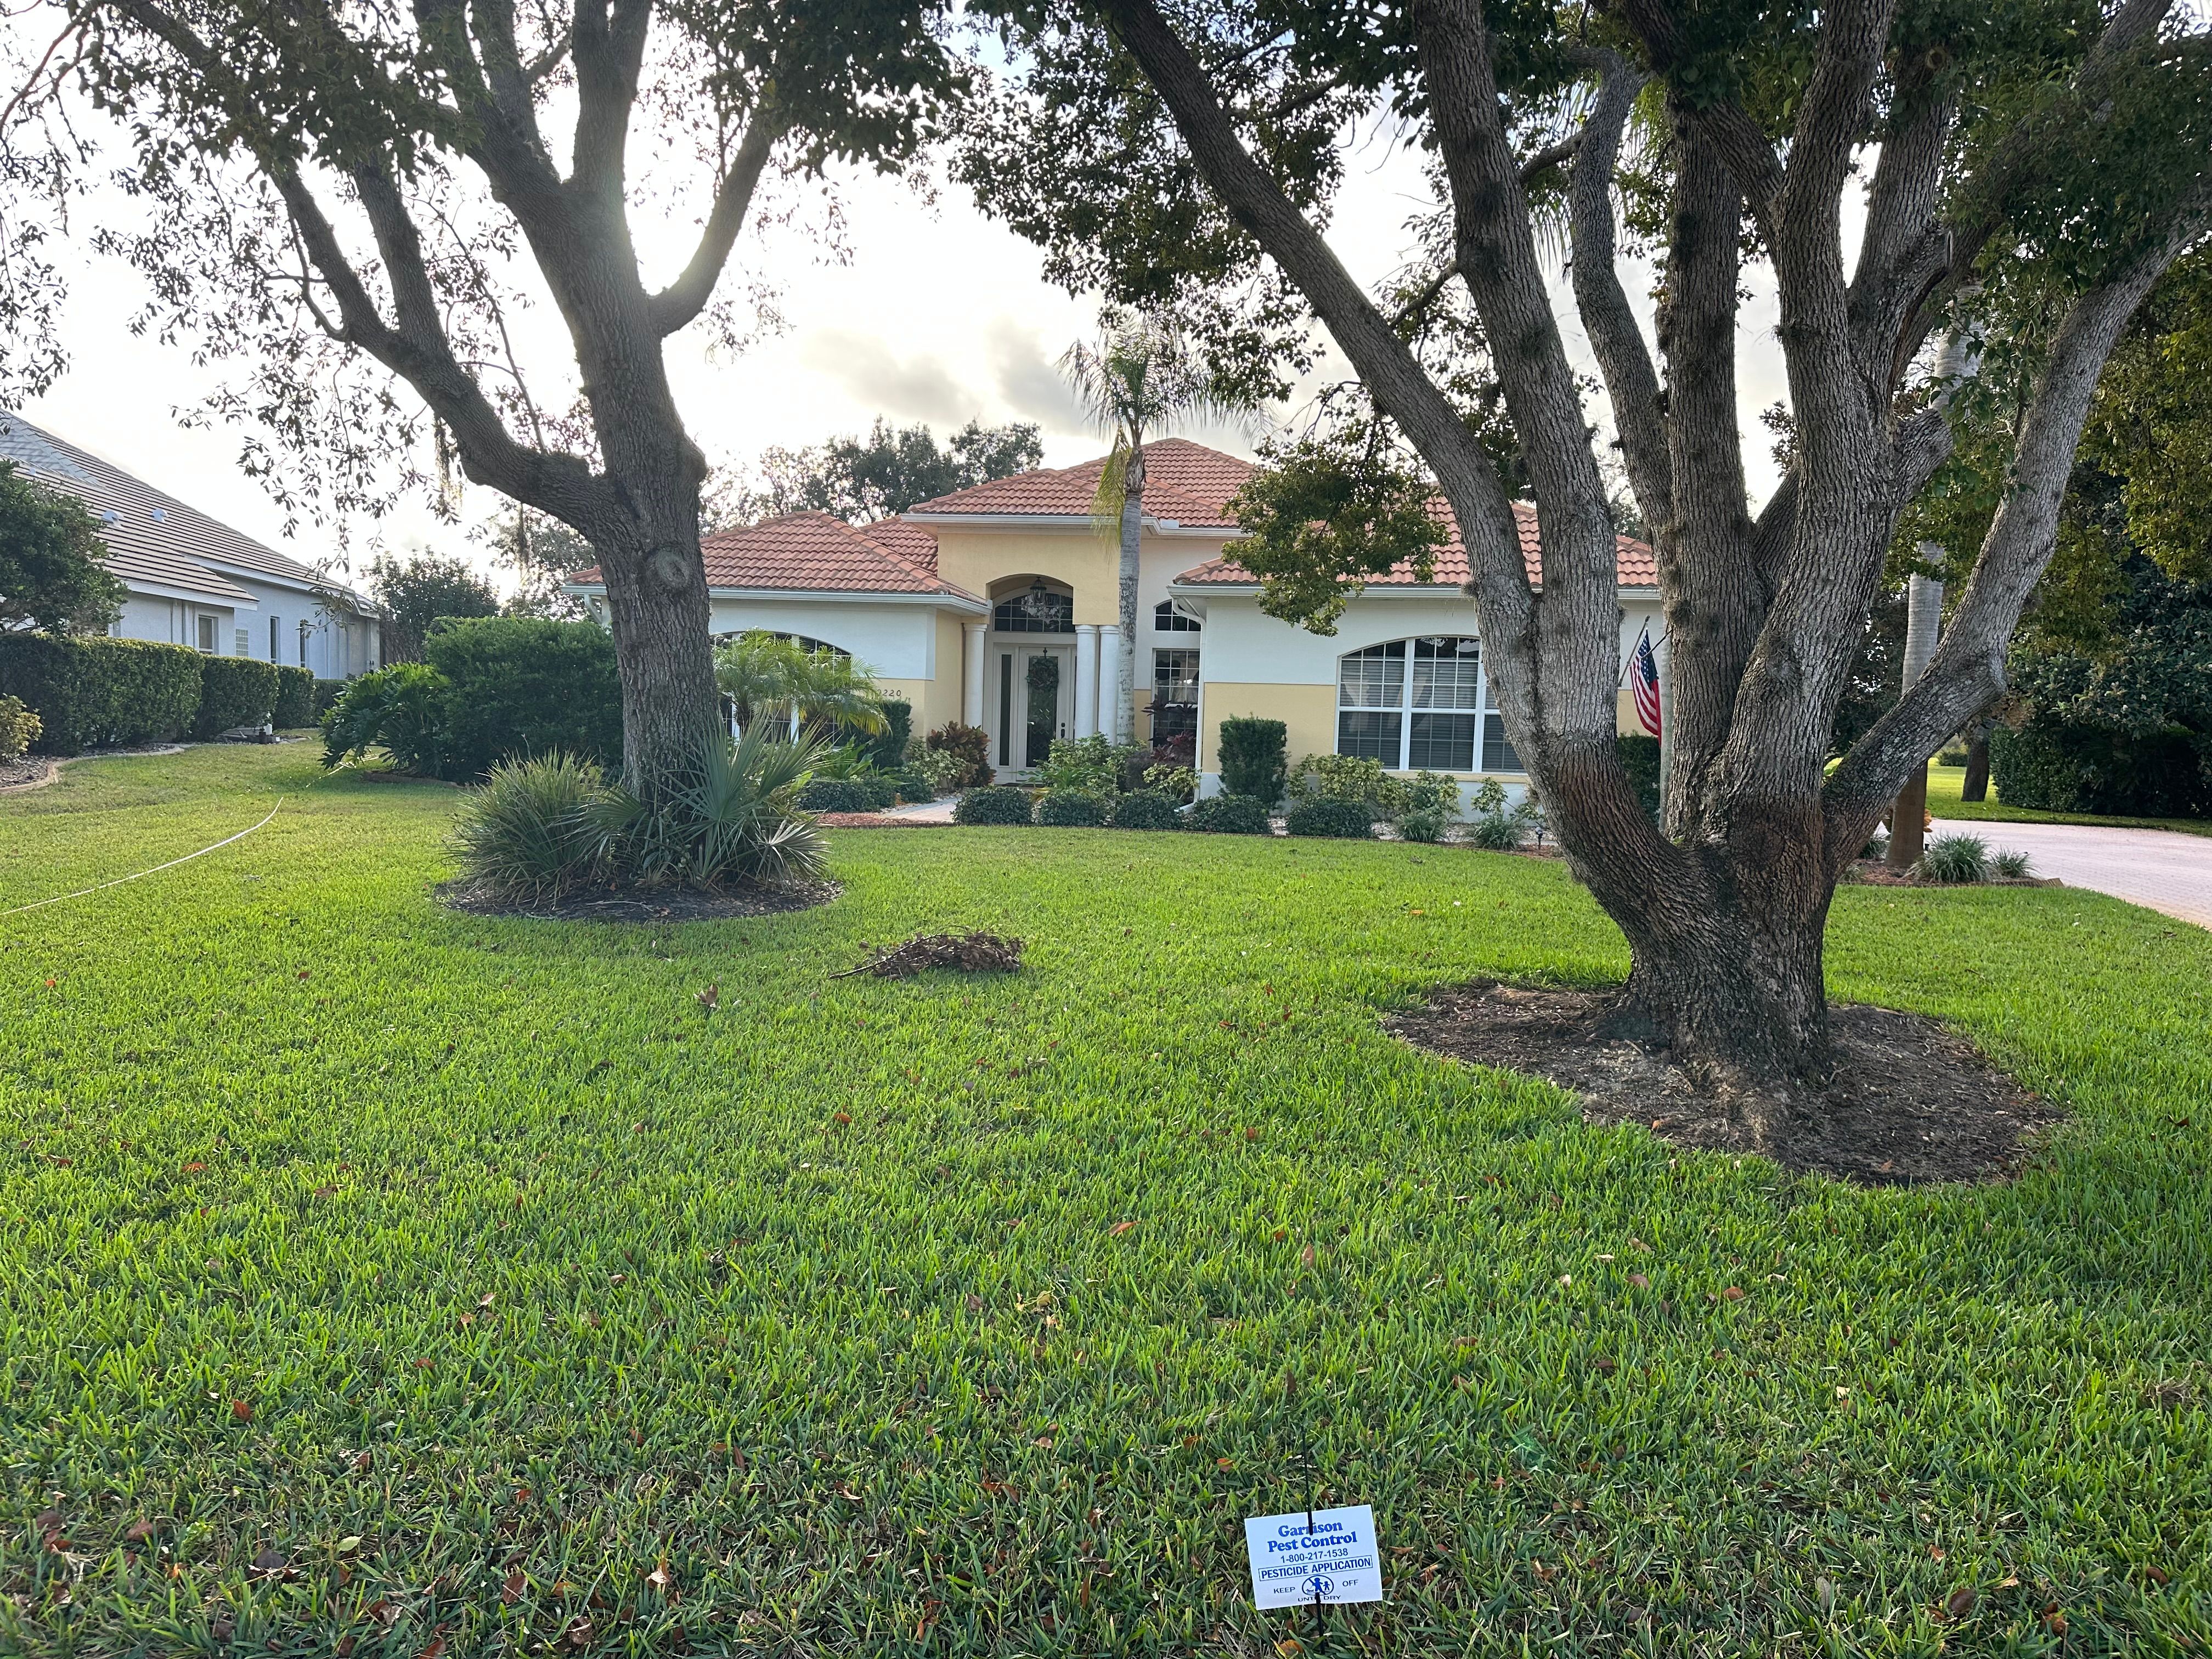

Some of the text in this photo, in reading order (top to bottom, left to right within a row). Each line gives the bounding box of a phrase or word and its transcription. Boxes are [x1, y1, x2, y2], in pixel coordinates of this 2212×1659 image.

[1268, 1531, 1357, 1552] Pest Control
[1280, 1548, 1348, 1563] 1-800-217-1538
[1261, 1558, 1370, 1579] PESTICIDE APPLICATION
